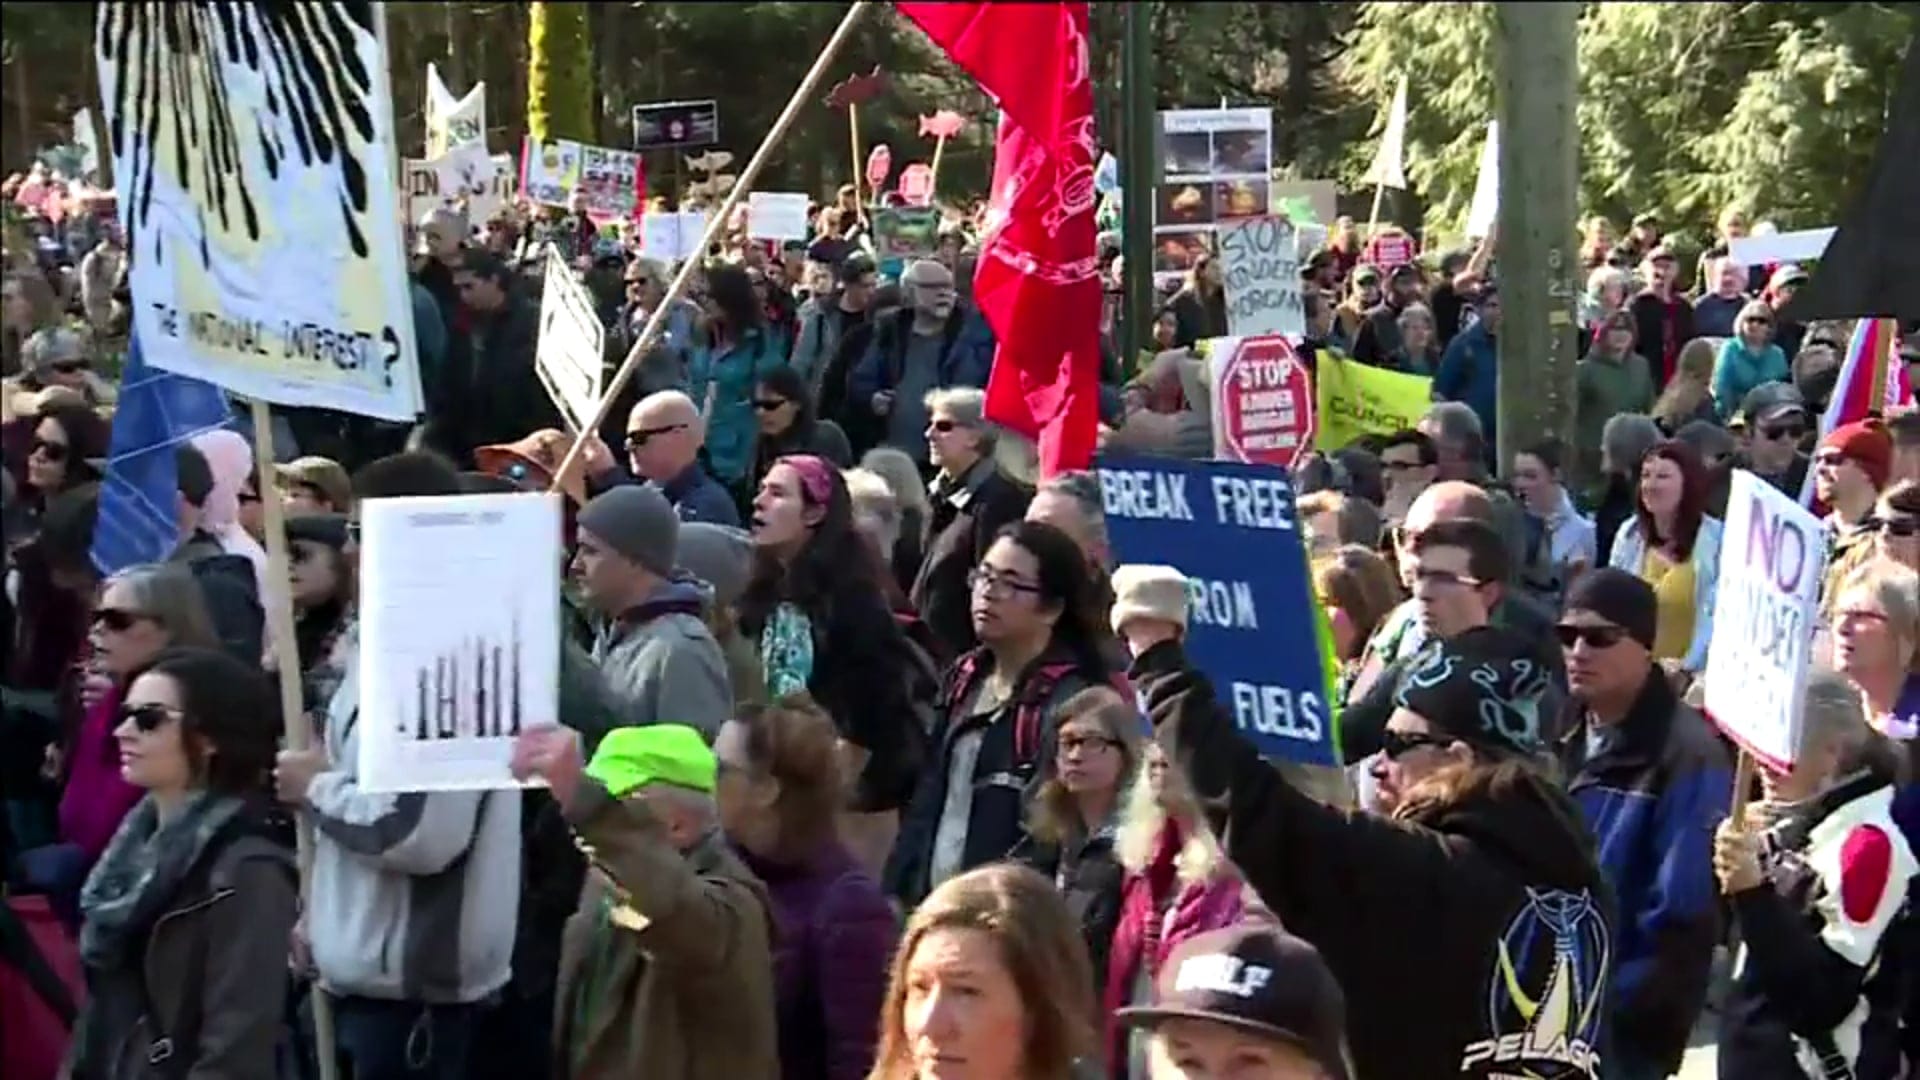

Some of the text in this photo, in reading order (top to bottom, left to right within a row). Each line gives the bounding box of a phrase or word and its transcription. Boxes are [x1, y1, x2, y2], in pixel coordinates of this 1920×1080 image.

[1222, 214, 1297, 265] STOP
[1238, 357, 1293, 389] STOP
[1098, 467, 1295, 530] BREAK FREE
[1745, 494, 1807, 594] NO
[1186, 575, 1259, 630] ROM
[1232, 680, 1323, 743] FUELS
